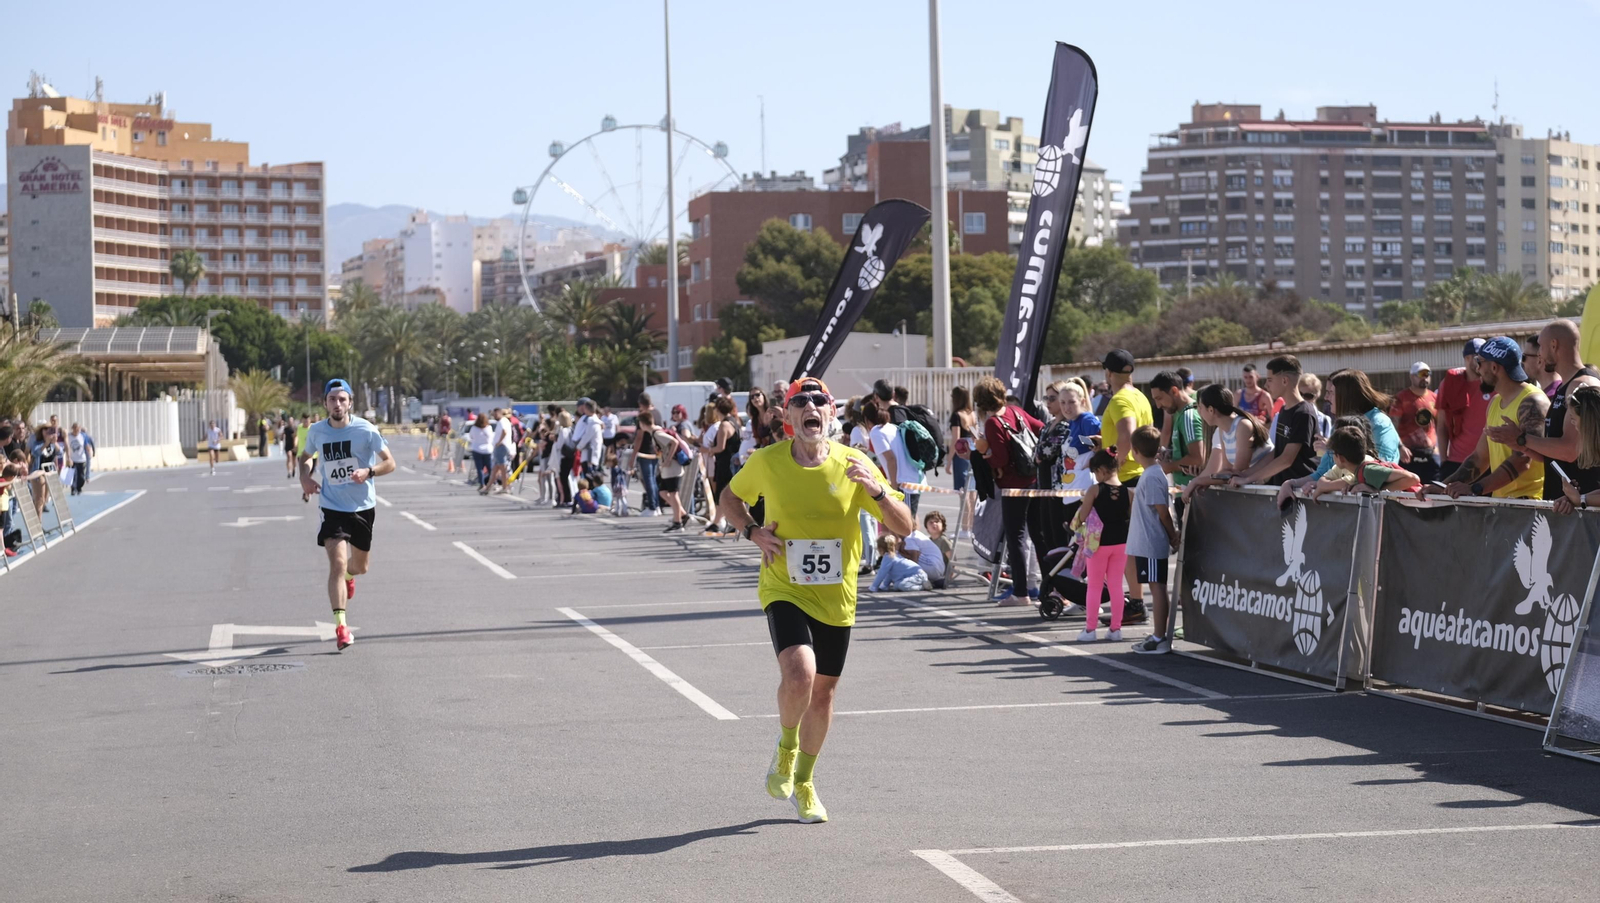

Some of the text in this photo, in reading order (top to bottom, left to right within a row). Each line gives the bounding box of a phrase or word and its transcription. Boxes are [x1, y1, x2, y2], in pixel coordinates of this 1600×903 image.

[19, 172, 83, 182] GRAN HOTEL
[22, 182, 80, 192] ALMERIA
[1483, 341, 1507, 358] Buff
[331, 465, 354, 479] 405
[802, 554, 831, 574] 55
[1191, 573, 1294, 622] aquéatacamos
[1398, 601, 1541, 657] aquéatacamos
